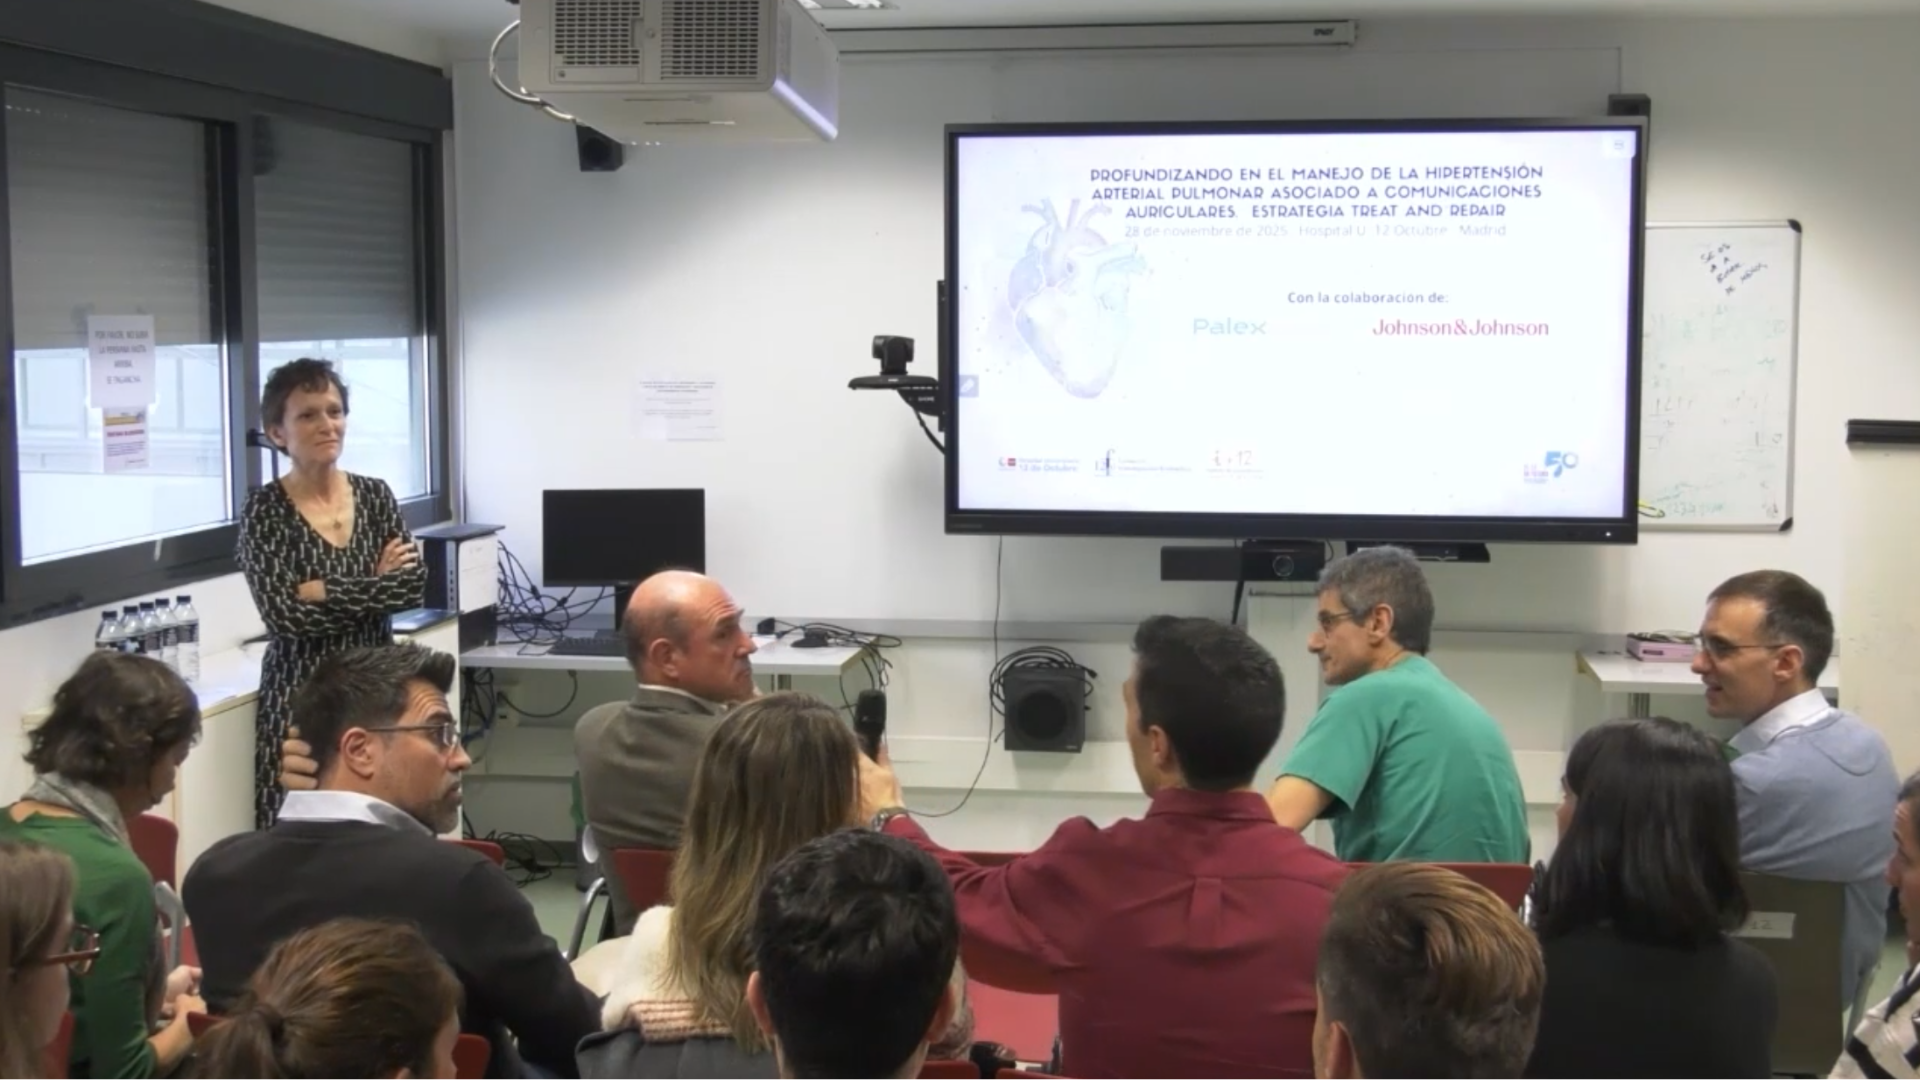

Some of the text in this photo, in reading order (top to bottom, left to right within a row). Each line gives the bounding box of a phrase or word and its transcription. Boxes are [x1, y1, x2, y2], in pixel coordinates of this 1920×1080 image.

[1090, 163, 1543, 182] PROFUNDIZANDO EN EL MANEJO DE LA HIPERTENSIÓN
[1091, 185, 1542, 200] ARTERIAL PULMONAR ASOCIADO A COMUNICACIONES
[1251, 205, 1344, 218] ESTRATEGIA
[1351, 205, 1398, 217] TREAT
[1405, 204, 1443, 217] AND
[1449, 204, 1507, 217] REPAIR
[1124, 226, 1140, 237] 28
[1143, 226, 1160, 237] de
[1163, 225, 1232, 237] noviembre
[1236, 226, 1253, 237] de
[1299, 224, 1353, 239] Hospital
[1375, 225, 1390, 236] 12
[1459, 224, 1507, 236] Madrid
[1287, 292, 1315, 303] Con
[1318, 292, 1330, 303] la
[1428, 292, 1449, 303] de:
[1193, 317, 1267, 335] Palex
[1372, 318, 1550, 336] Johnson&Johnson
